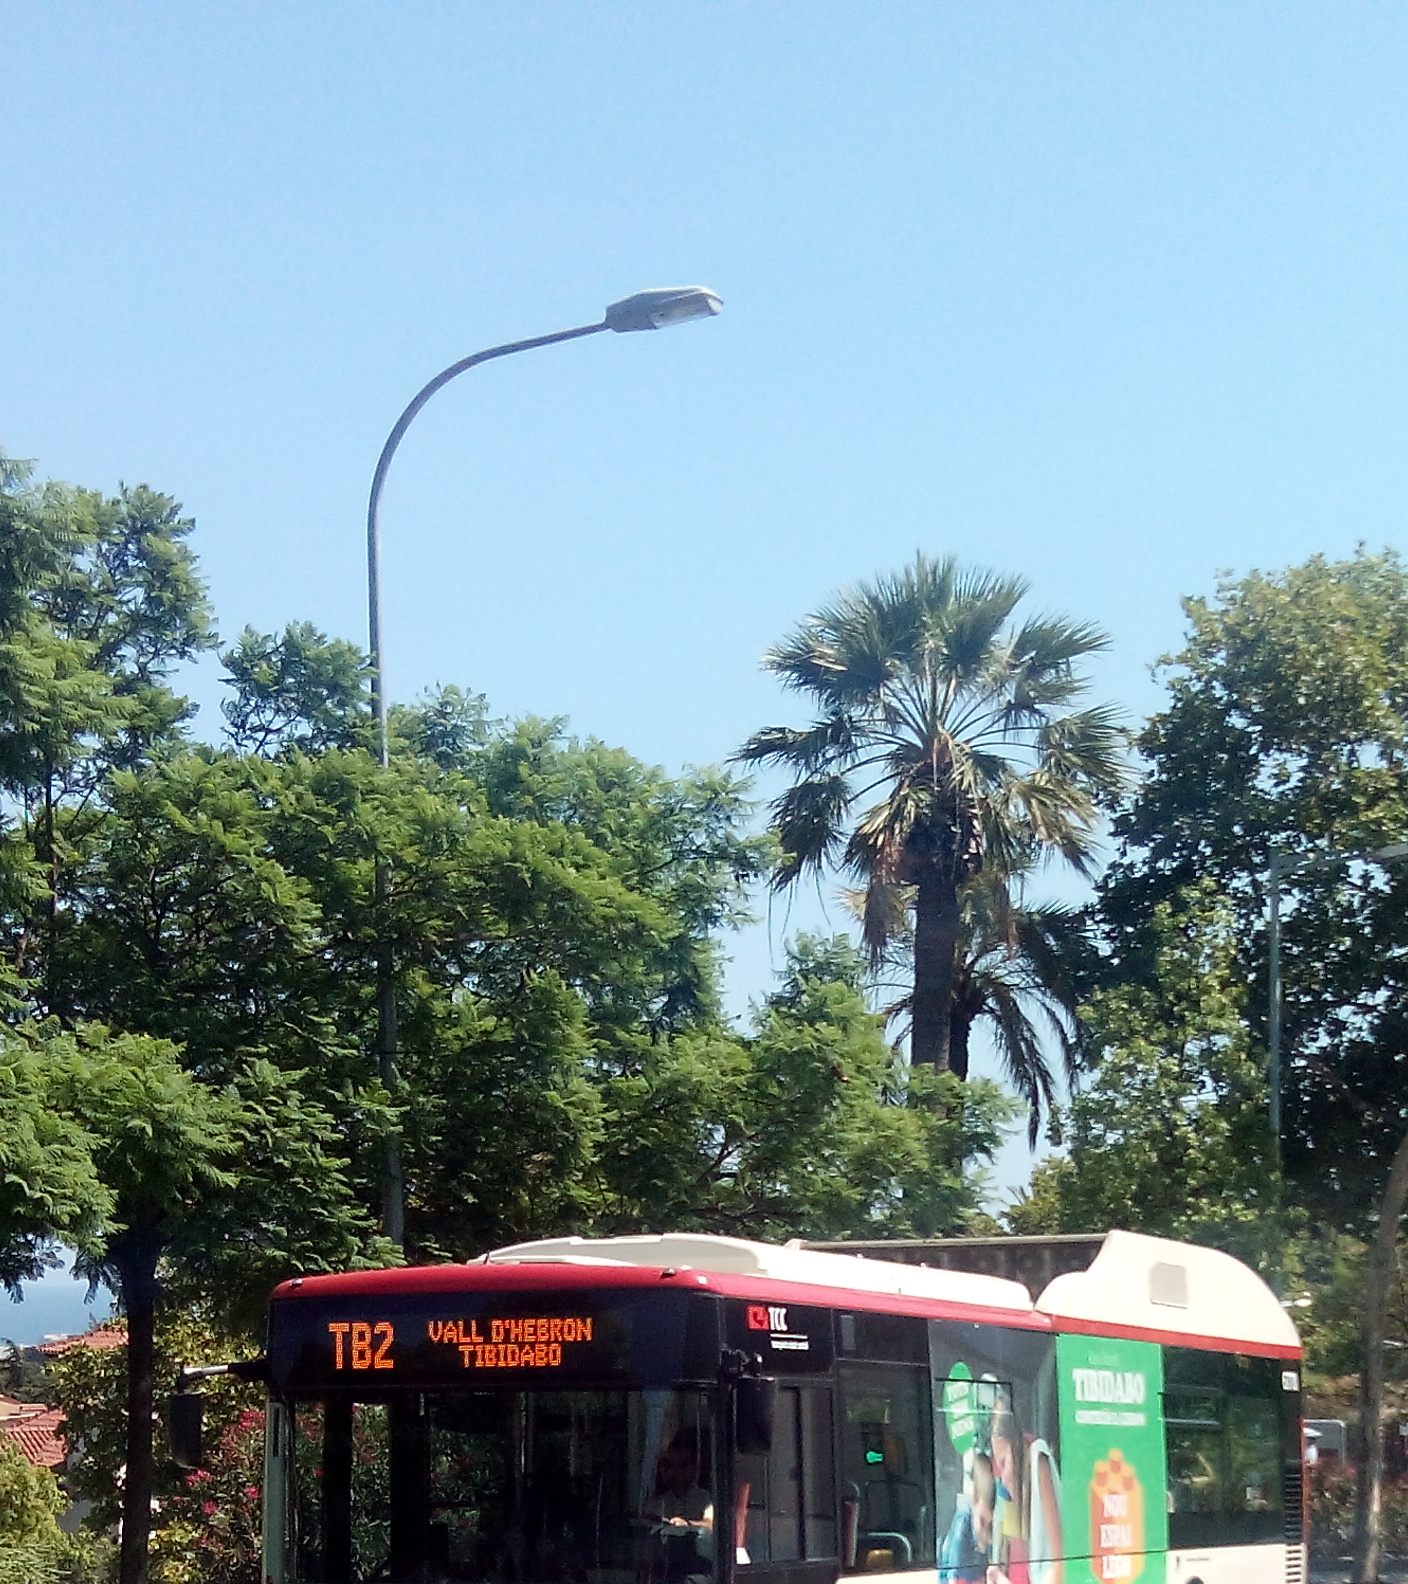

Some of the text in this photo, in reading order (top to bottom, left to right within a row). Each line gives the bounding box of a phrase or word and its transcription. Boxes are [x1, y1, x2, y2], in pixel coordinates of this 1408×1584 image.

[328, 1321, 394, 1370] TB2
[428, 1319, 484, 1344] VALL
[458, 1343, 562, 1368] TIBIDABO
[1072, 1368, 1145, 1404] TIBIDABO
